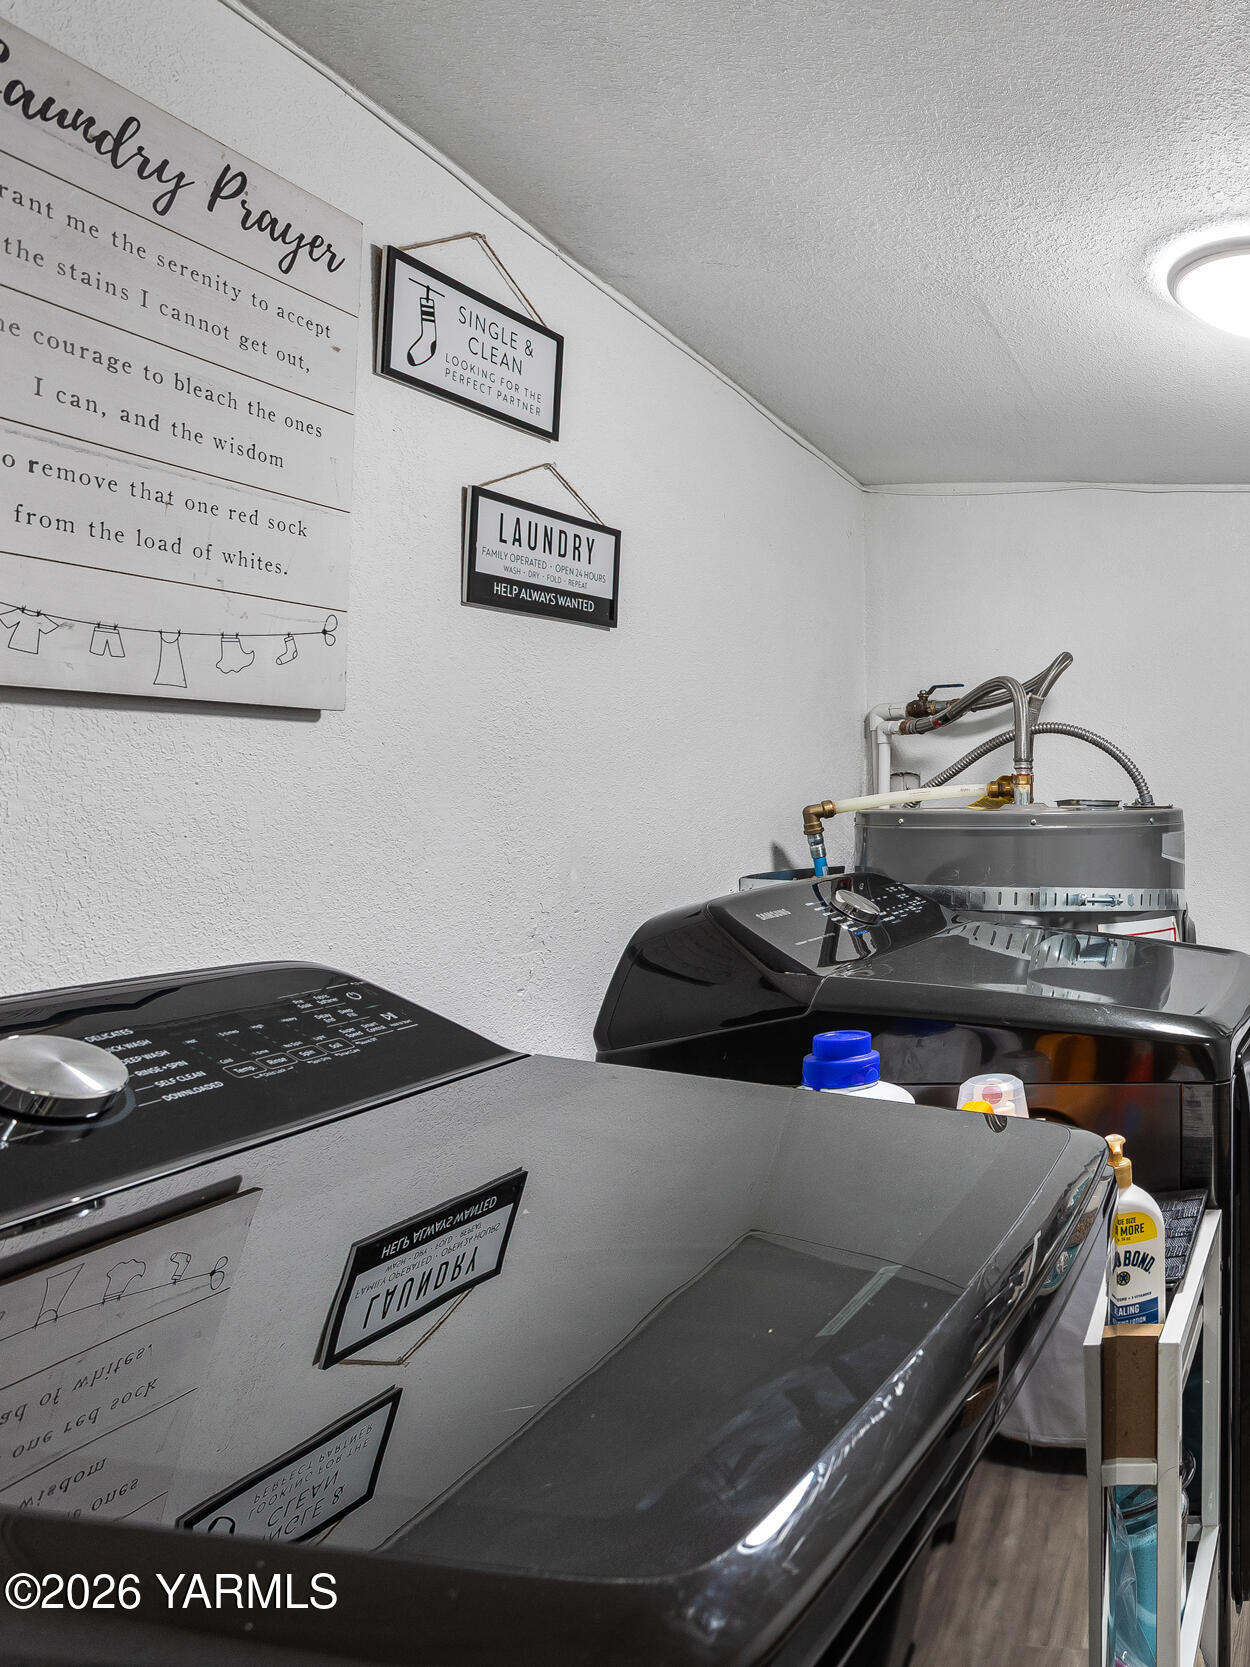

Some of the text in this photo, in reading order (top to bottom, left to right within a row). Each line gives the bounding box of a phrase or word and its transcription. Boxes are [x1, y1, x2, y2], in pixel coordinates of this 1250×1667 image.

[0, 38, 346, 275] aundry Prayer
[0, 184, 332, 341] rant me the serenity to accept
[3, 237, 311, 374] the stains I cannot get out,
[458, 305, 534, 358] SINGLE &
[467, 336, 523, 377] CLEAN
[33, 329, 323, 438] courage to bleach the ones
[444, 367, 542, 417] PERFECT PARTNER
[445, 352, 542, 404] LOOKING FOR THE
[33, 375, 284, 468] I can, and the wisdom
[0, 453, 309, 538] o remove that one red sock
[13, 503, 289, 576] from the load of whites.
[498, 512, 595, 566] LAUNDRY
[481, 546, 607, 584] FAMILY OPERATED OPEN 24 HOURS
[503, 565, 588, 590] WASH DRY FOLD REPEAT
[493, 581, 595, 613] HELP ALWAYS WANTED
[84, 1028, 134, 1043] DELICATES
[125, 1039, 152, 1050] WASH
[143, 1050, 171, 1061] WASH
[153, 1070, 207, 1088] SELF CLEAN
[161, 1081, 224, 1102] DOWNLOADED
[1120, 1222, 1145, 1237] MORE
[1125, 1217, 1137, 1225] SIZE
[1123, 1250, 1156, 1273] BOND
